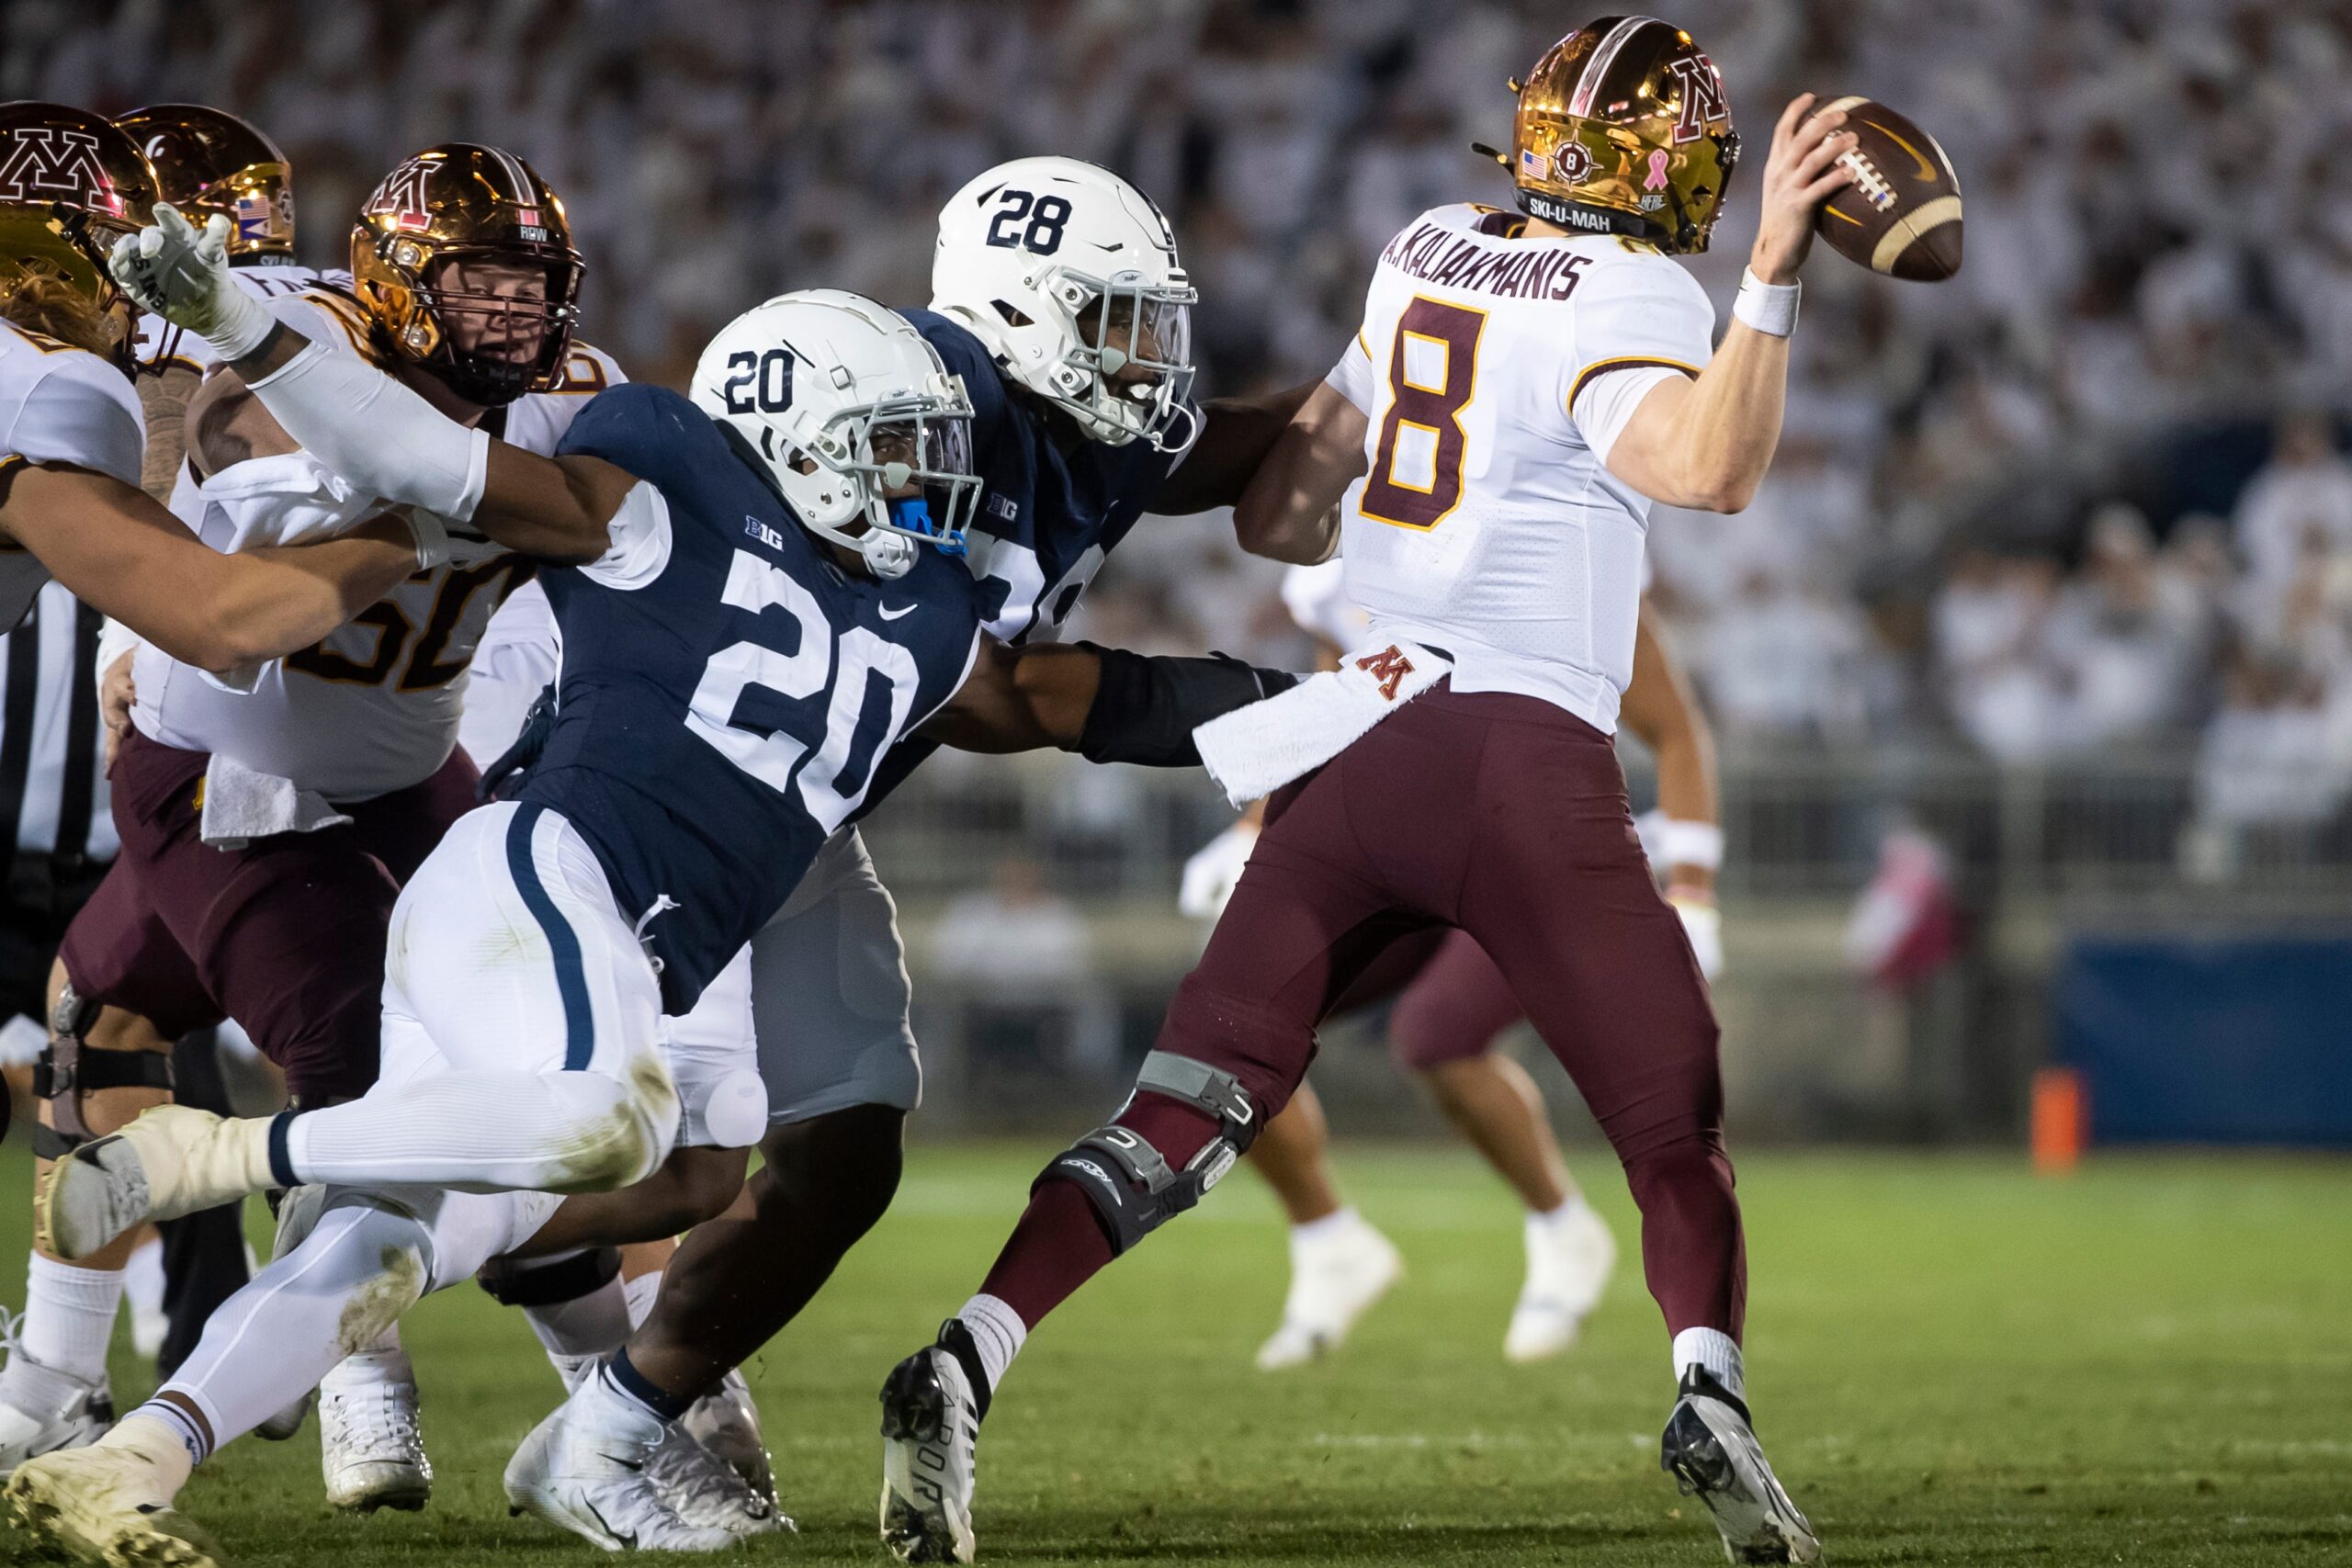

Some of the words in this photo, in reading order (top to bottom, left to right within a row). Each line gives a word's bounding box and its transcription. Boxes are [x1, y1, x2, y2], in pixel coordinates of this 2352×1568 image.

[0, 129, 124, 217] M
[1566, 154, 1577, 171] 8
[986, 189, 1073, 257] 28
[1530, 197, 1611, 232] SKI-U-MAH
[724, 348, 796, 415] 20
[1358, 292, 1490, 533] 8
[684, 547, 921, 838] 20
[1355, 644, 1416, 702] M
